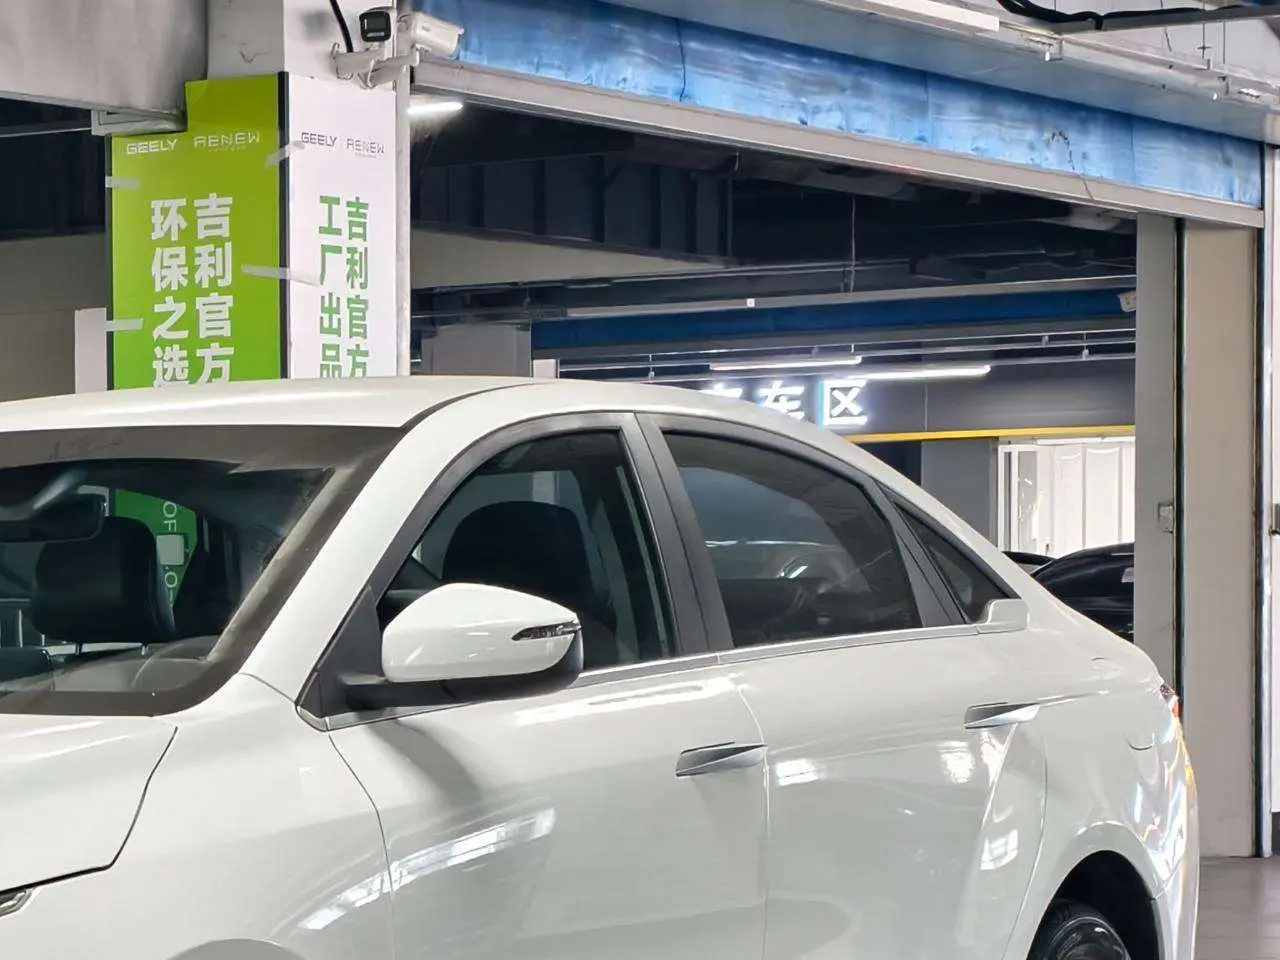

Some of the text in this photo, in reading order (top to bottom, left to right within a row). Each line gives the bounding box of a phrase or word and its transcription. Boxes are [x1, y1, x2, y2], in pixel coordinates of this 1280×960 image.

[126, 138, 178, 155] GEELY
[193, 131, 261, 148] RENEW
[301, 132, 338, 147] GEELY
[150, 197, 189, 389] 环保之选
[193, 192, 234, 384] 吉利官方
[318, 194, 343, 379] 工厂出品
[346, 196, 370, 379] 吉利官方
[698, 379, 869, 426] 车区
